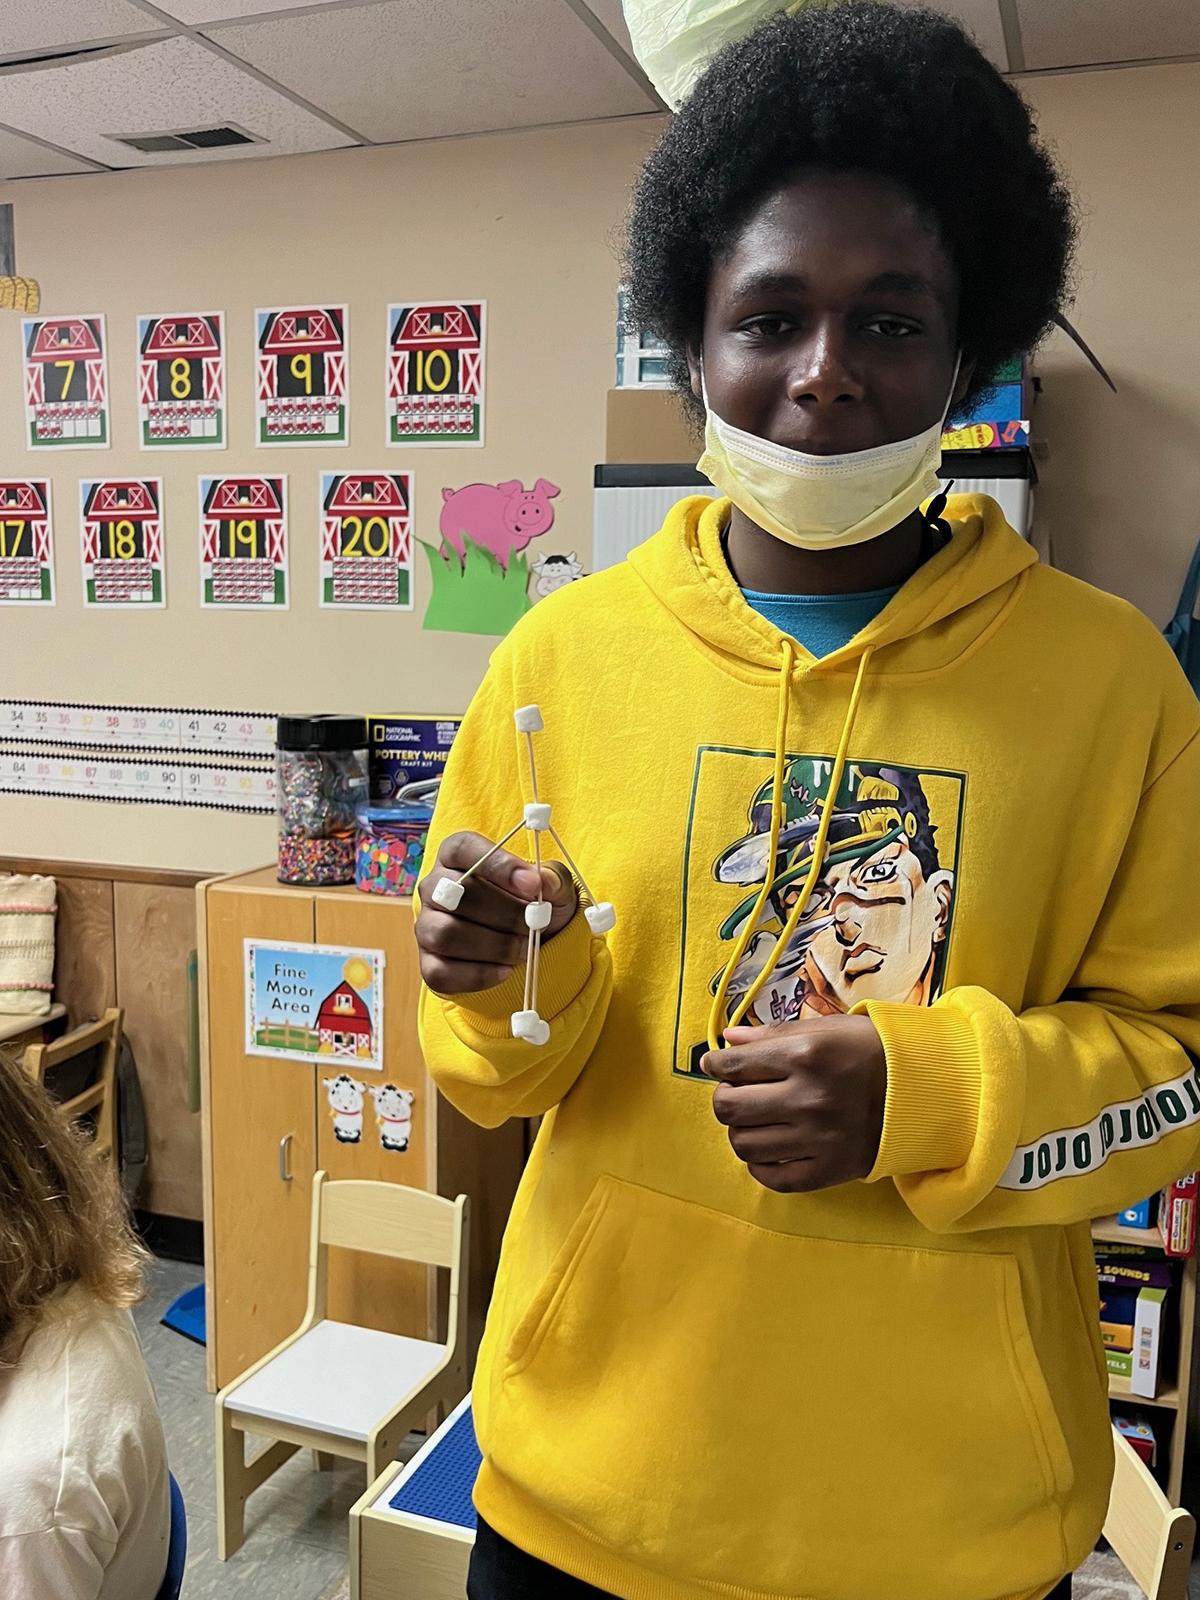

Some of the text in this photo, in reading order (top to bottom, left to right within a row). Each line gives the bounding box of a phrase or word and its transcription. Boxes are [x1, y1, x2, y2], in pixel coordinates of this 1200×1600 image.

[54, 359, 76, 400] 7
[170, 357, 191, 399] 8
[290, 353, 312, 395] 9
[415, 349, 453, 393] 10
[0, 519, 26, 558] 17
[108, 519, 136, 560] 18
[228, 519, 258, 559] 19
[341, 516, 390, 558] 20
[11, 710, 24, 722] 34
[35, 711, 48, 723] 35
[59, 713, 71, 725] 36
[106, 716, 120, 728] 38
[133, 717, 146, 729] 39
[159, 719, 175, 730] 40
[188, 720, 200, 731] 41
[213, 721, 228, 733] 42
[239, 722, 254, 735] 43
[13, 762, 26, 773] 84
[38, 763, 50, 774] 85
[85, 767, 98, 778] 87
[110, 769, 122, 780] 88
[136, 770, 149, 782] 89
[162, 772, 176, 783] 90
[190, 773, 201, 785] 91
[214, 775, 227, 786] 92
[375, 749, 449, 762] POTTERY WHE
[266, 980, 315, 997] Motor
[274, 963, 306, 979] Fine
[271, 997, 311, 1014] Area
[1019, 1132, 1092, 1184] JOJO
[1094, 1244, 1146, 1256] ILDING
[1103, 1264, 1151, 1282] SOUNDS
